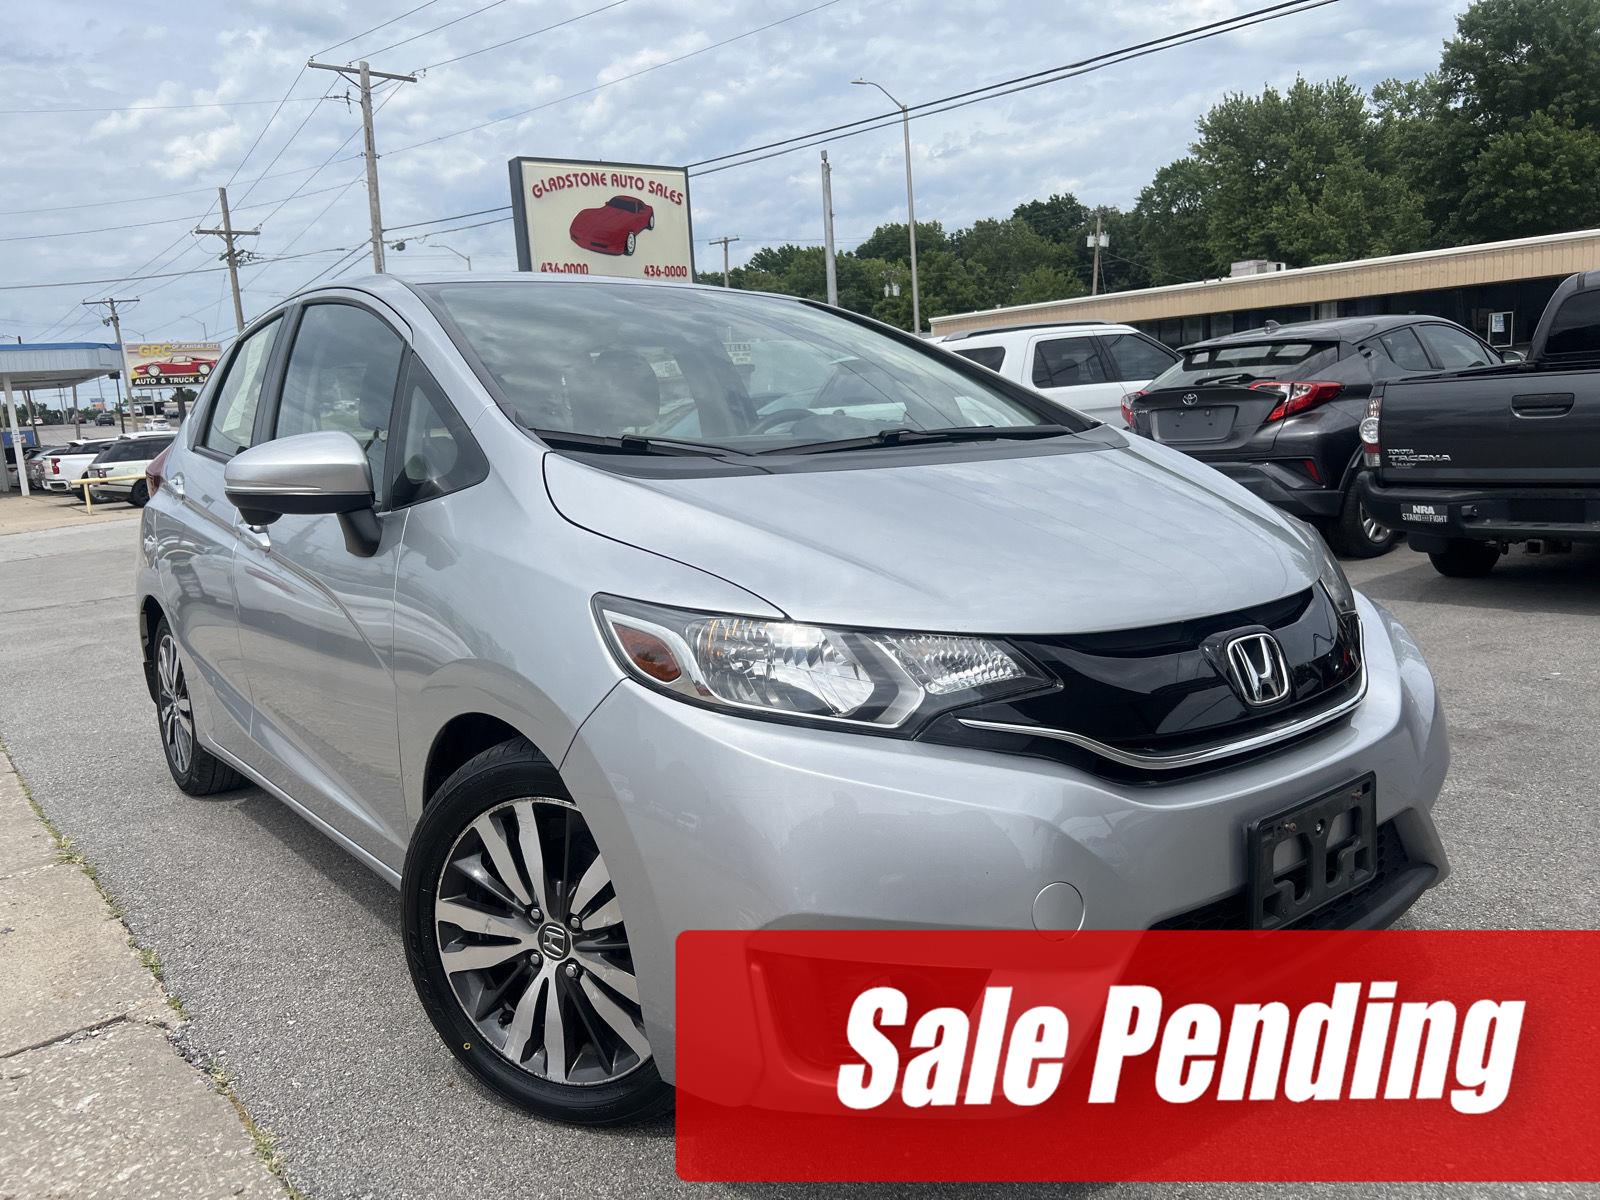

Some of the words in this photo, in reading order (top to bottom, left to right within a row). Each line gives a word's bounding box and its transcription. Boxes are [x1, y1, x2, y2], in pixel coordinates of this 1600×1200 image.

[532, 172, 607, 199] GLADSTONE
[611, 173, 645, 191] AUTO
[648, 180, 684, 206] SALES
[644, 265, 687, 278] 436-0000
[138, 344, 172, 357] GRC
[1412, 505, 1435, 515] NRA
[1401, 513, 1421, 522] STAND
[1430, 515, 1448, 523] FIGHT
